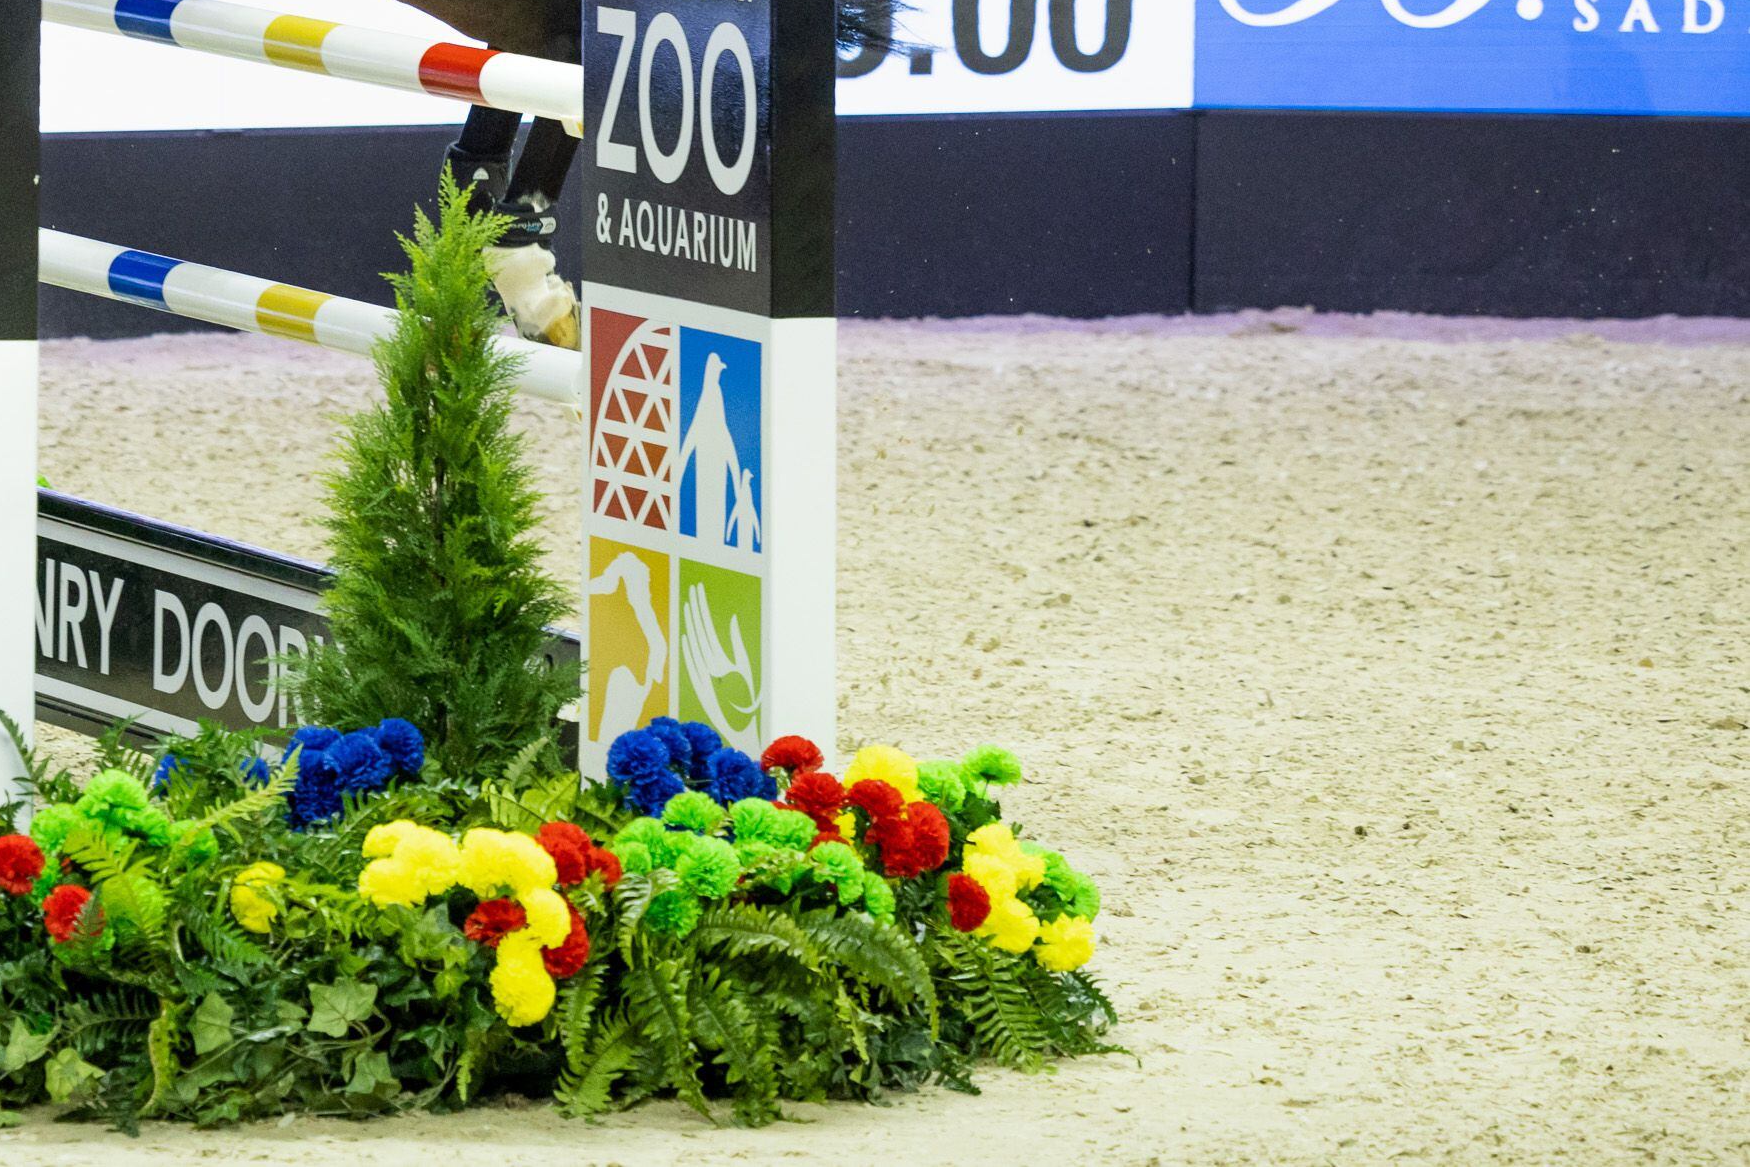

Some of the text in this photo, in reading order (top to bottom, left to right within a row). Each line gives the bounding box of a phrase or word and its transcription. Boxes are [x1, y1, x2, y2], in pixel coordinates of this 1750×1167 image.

[596, 5, 757, 196] ZOO
[596, 192, 757, 272] & AQUARIUM
